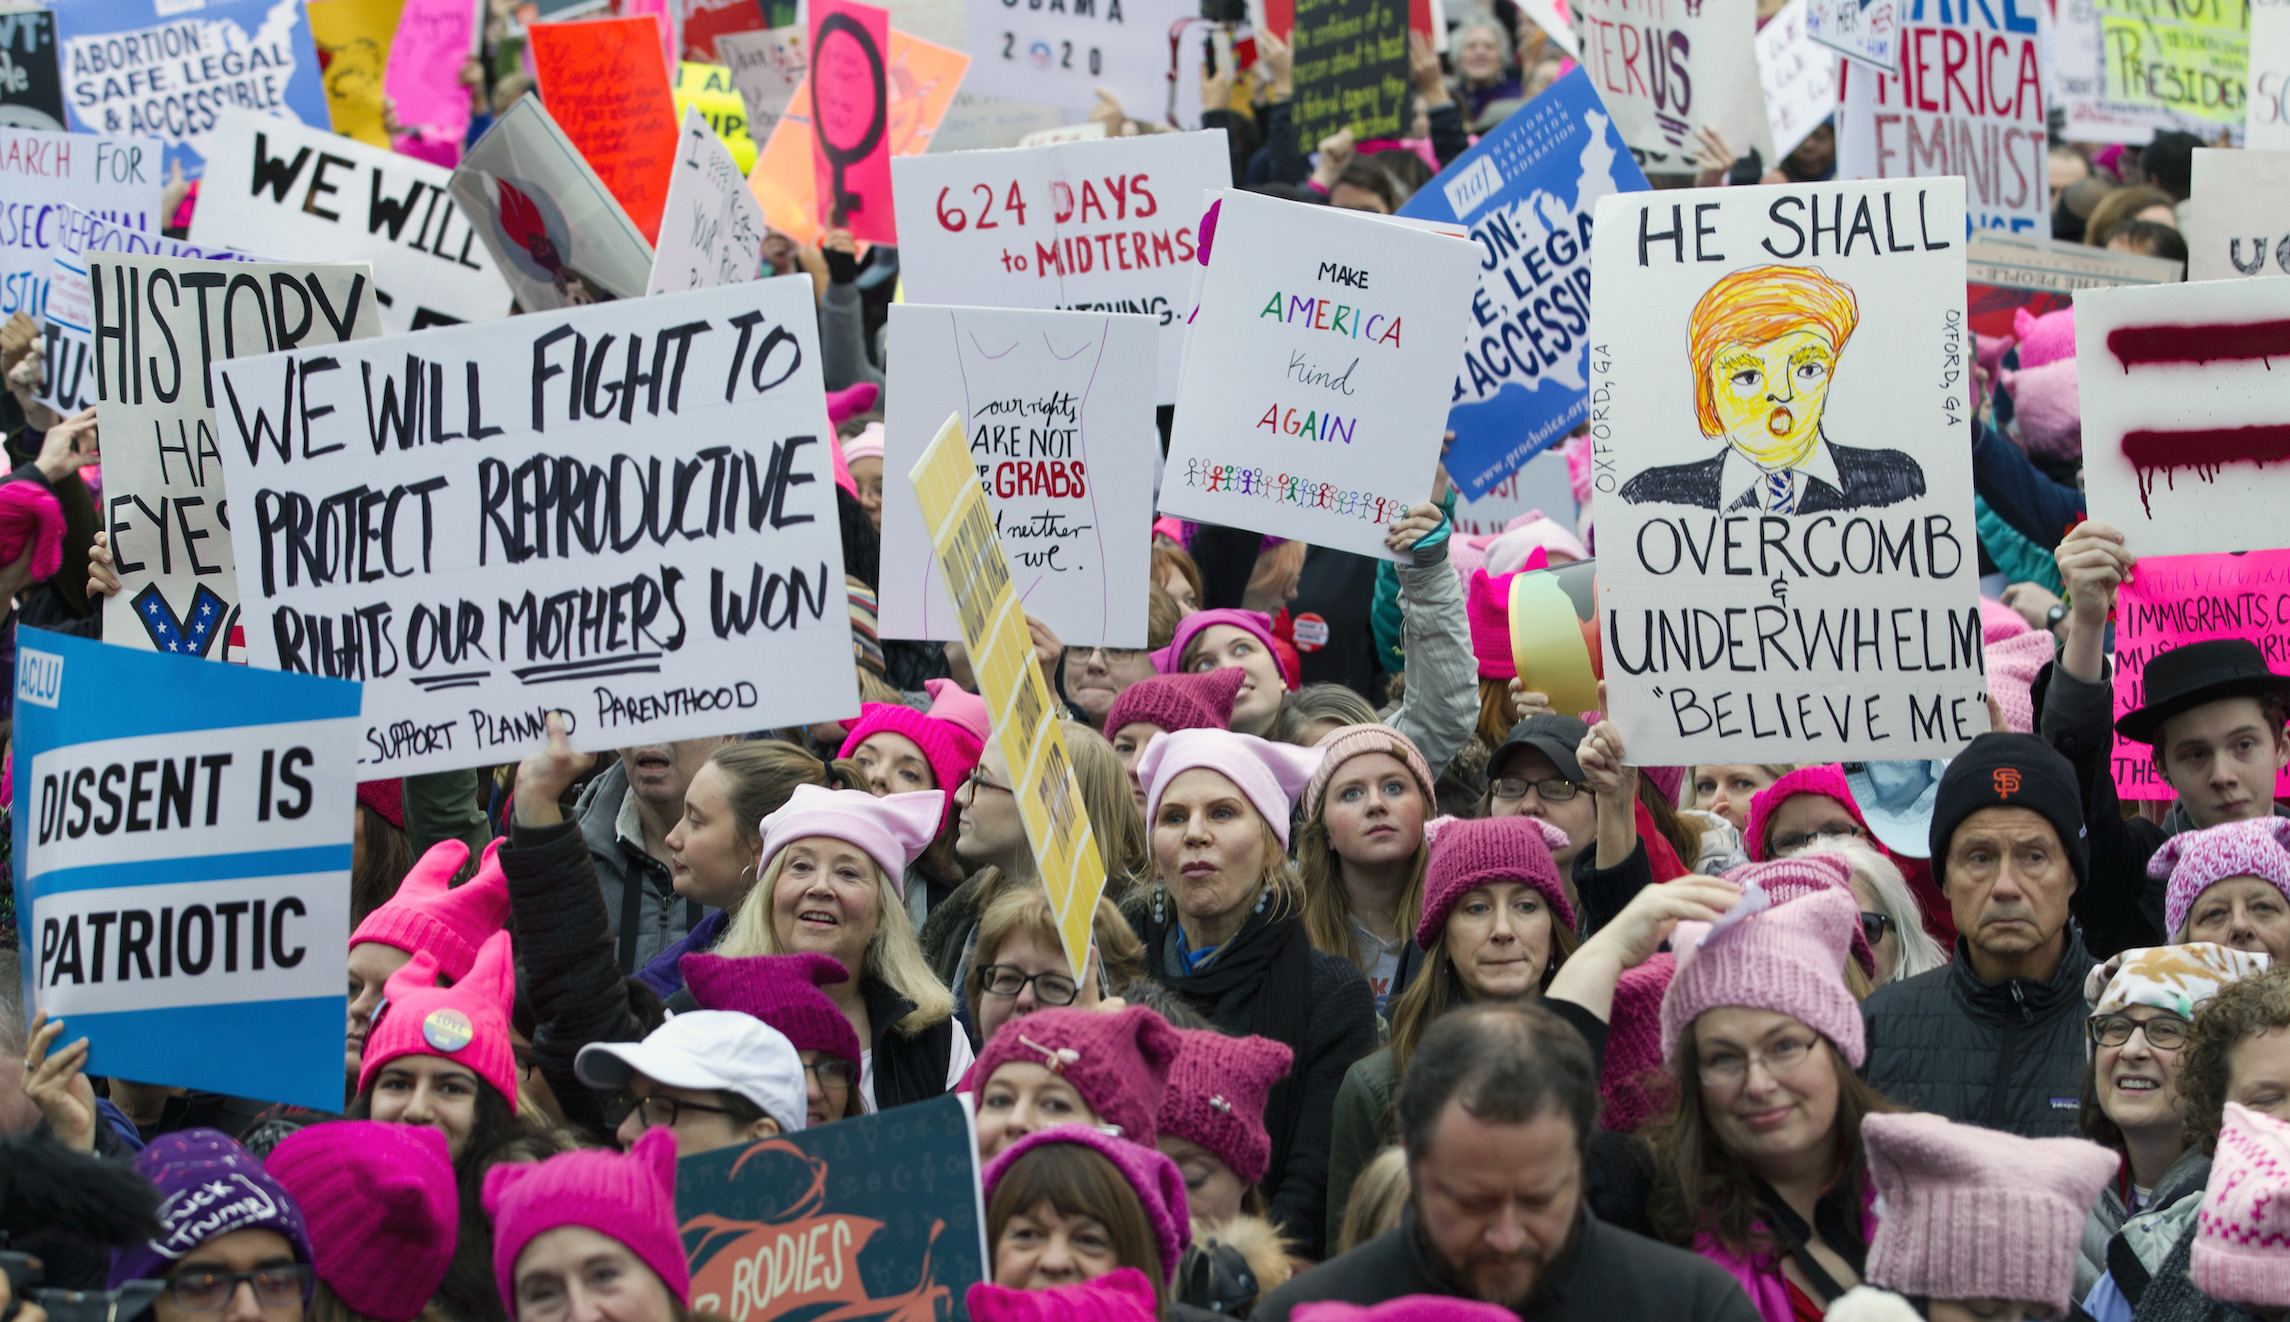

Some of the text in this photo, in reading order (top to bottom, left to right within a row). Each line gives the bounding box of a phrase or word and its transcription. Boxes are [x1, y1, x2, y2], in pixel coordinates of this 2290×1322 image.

[182, 42, 291, 85] LEGAL
[104, 107, 121, 132] &
[1493, 98, 1562, 158] NATIONAL
[1500, 111, 1569, 169] ABORTION
[96, 142, 147, 184] FOR
[251, 131, 356, 223] WE
[1454, 152, 1494, 208] naf
[1506, 122, 1576, 182] FEDERATION
[936, 172, 1158, 232] 624 DAYS
[1638, 202, 1726, 267] HE
[1761, 190, 1950, 259] SHALL
[1001, 227, 1196, 279] to MIDTERMS
[1318, 261, 1369, 289] MAKE
[90, 263, 366, 408] HISTORY
[1260, 291, 1402, 349] AMERICA
[1593, 344, 1613, 374] GA
[221, 309, 802, 467] WE WILL FIGHT TO
[1026, 390, 1080, 428] rights
[1942, 397, 1962, 427] GA
[970, 424, 1078, 459] ARE NOT
[1256, 403, 1357, 445] AGAIN
[995, 461, 1086, 499] GRABS
[255, 435, 818, 598] PROTECT REPRODUCTIVE
[1007, 509, 1092, 539] neither
[1637, 514, 1962, 579] OVERCOMB
[272, 602, 399, 681] RIGHTS
[406, 597, 495, 671] OUR
[711, 560, 828, 641] WON
[1610, 605, 1985, 677] UNDERWHELM
[2128, 593, 2272, 638] IMMIGRANTS,
[20, 656, 59, 700] ACLU
[469, 705, 576, 751] PLANND
[594, 681, 758, 729] PARENTHOOD
[1653, 687, 1988, 744] "BELIEVE ME"
[38, 746, 315, 847] DISSENT IS
[40, 896, 307, 990] PATRIOTIC
[436, 1012, 466, 1033] LOVE
[731, 1218, 852, 1322] BODIES
